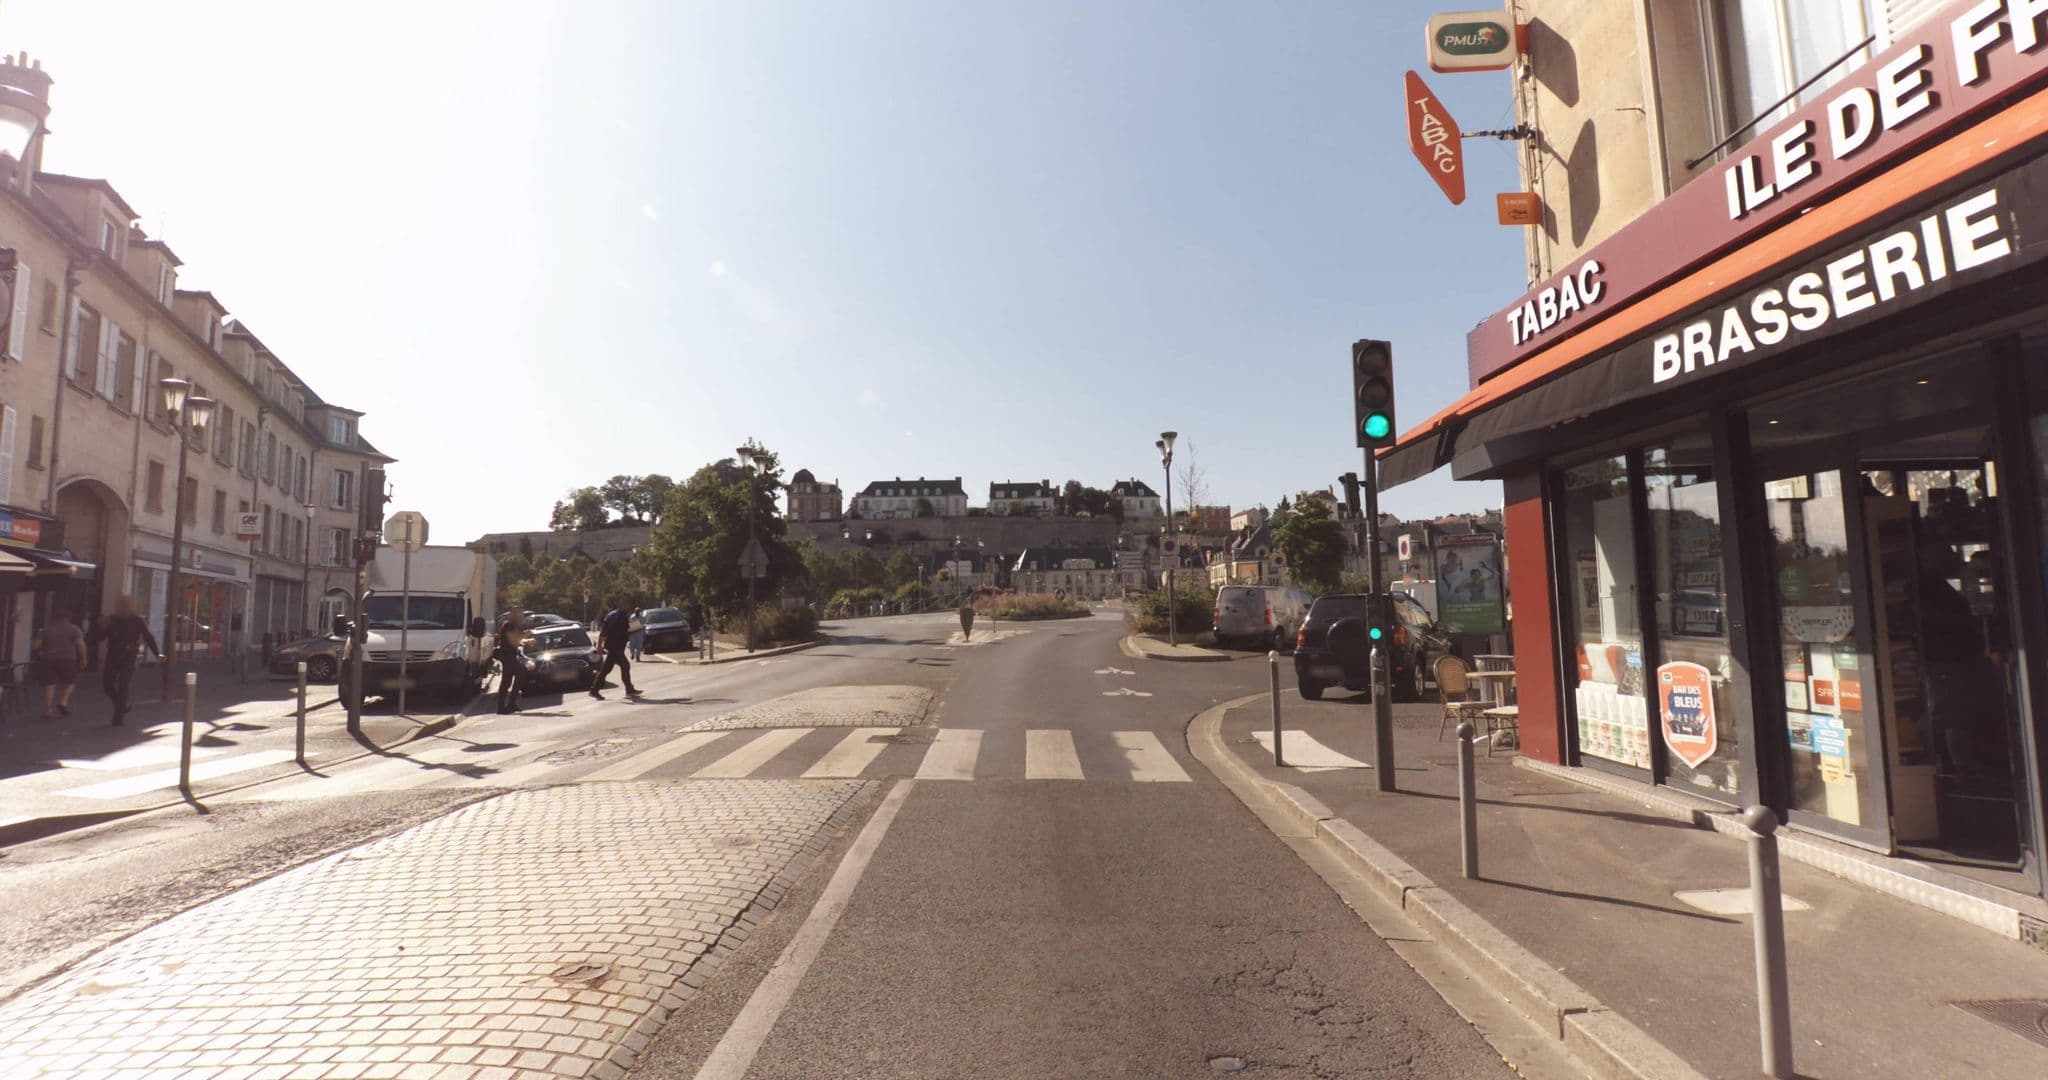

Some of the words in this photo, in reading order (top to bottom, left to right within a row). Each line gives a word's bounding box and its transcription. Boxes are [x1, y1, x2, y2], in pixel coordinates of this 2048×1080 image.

[1444, 35, 1476, 46] PMU
[1414, 97, 1456, 173] TABAC
[1725, 120, 1813, 220] ILE
[1827, 44, 1931, 160] DE
[1506, 259, 1603, 346] TABAC
[1652, 188, 2012, 384] BRASSERIE
[1674, 695, 1703, 709] BLEUS
[1818, 687, 1834, 697] SFR
